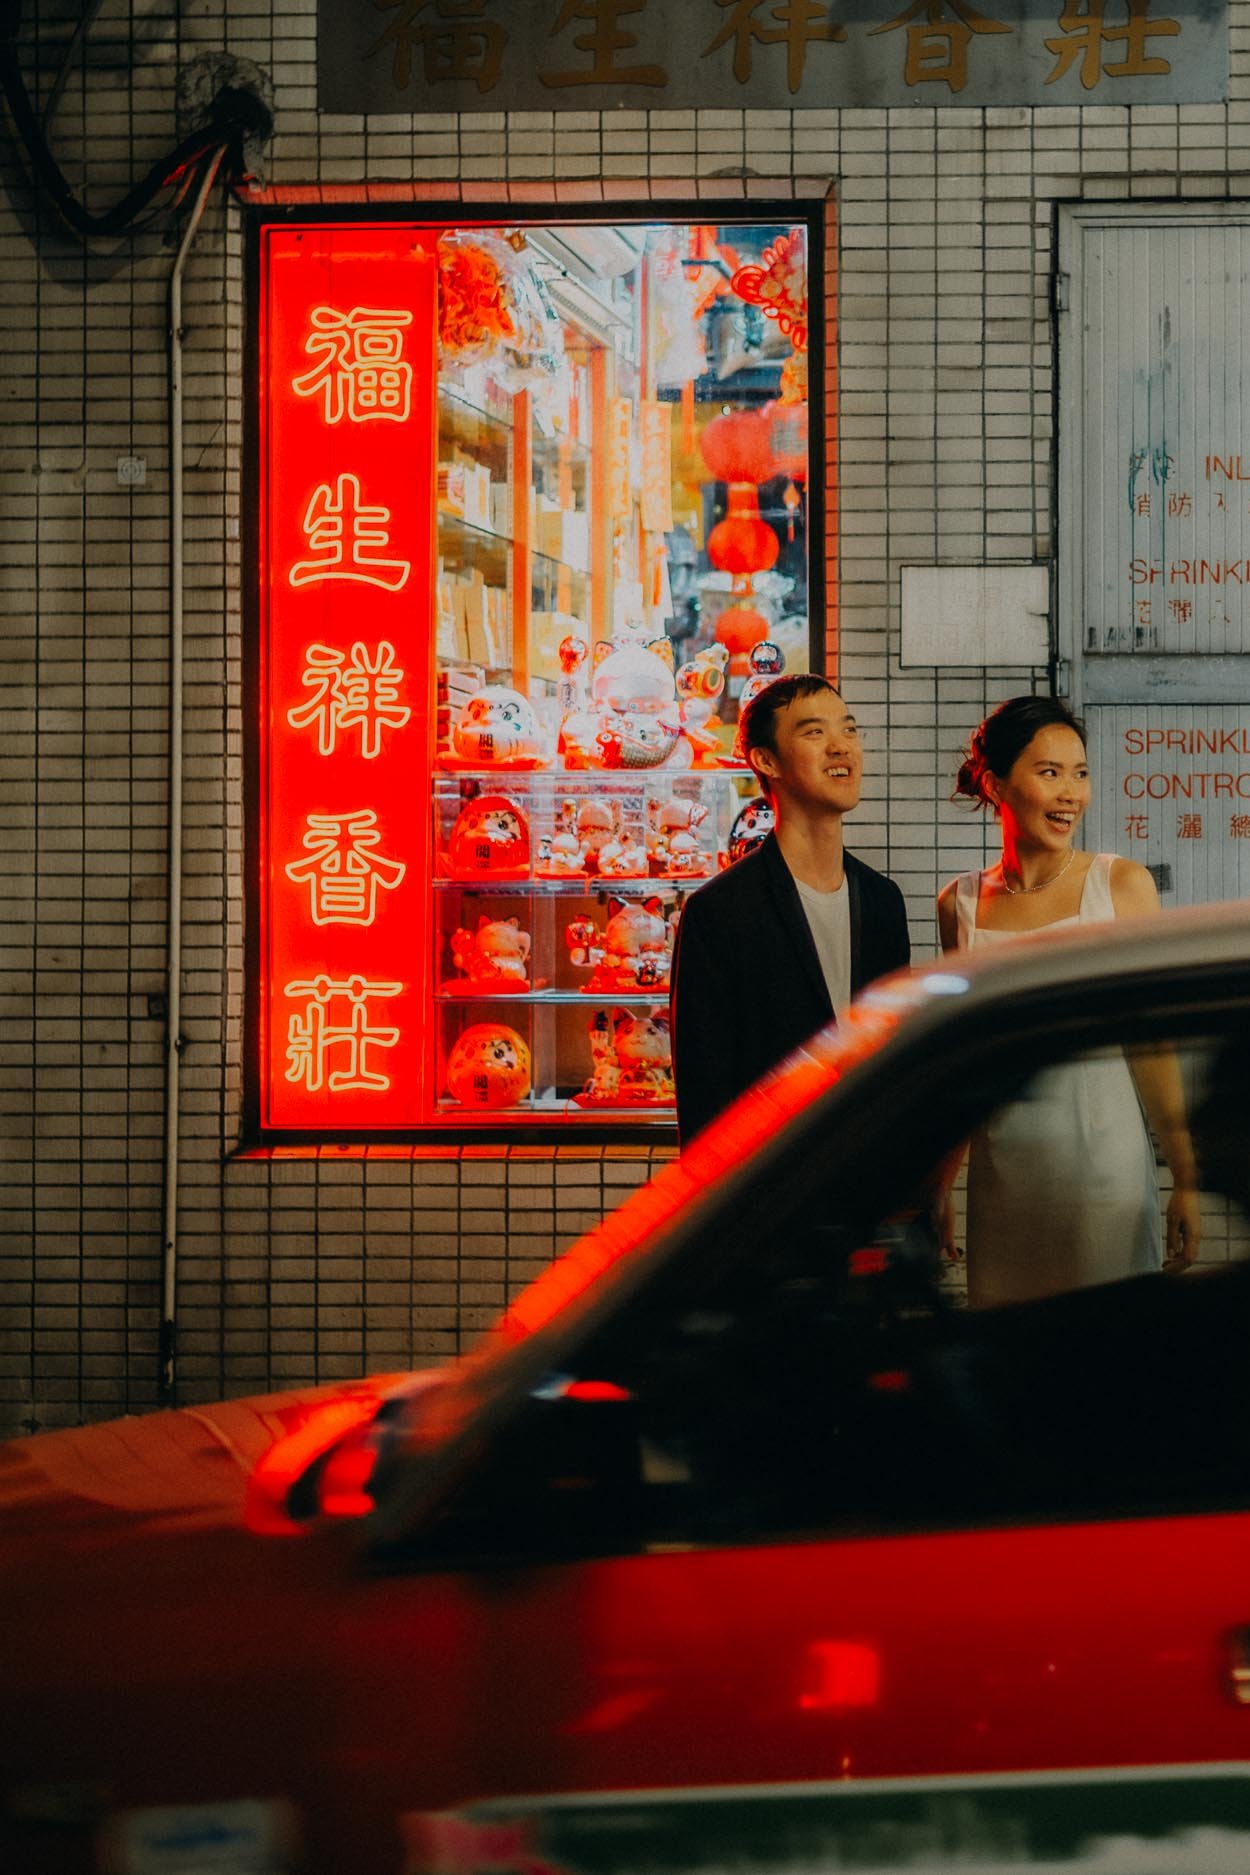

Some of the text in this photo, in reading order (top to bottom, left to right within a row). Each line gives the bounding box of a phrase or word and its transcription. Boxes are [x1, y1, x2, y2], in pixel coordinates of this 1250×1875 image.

[283, 306, 414, 1093] 福生祥香莊
